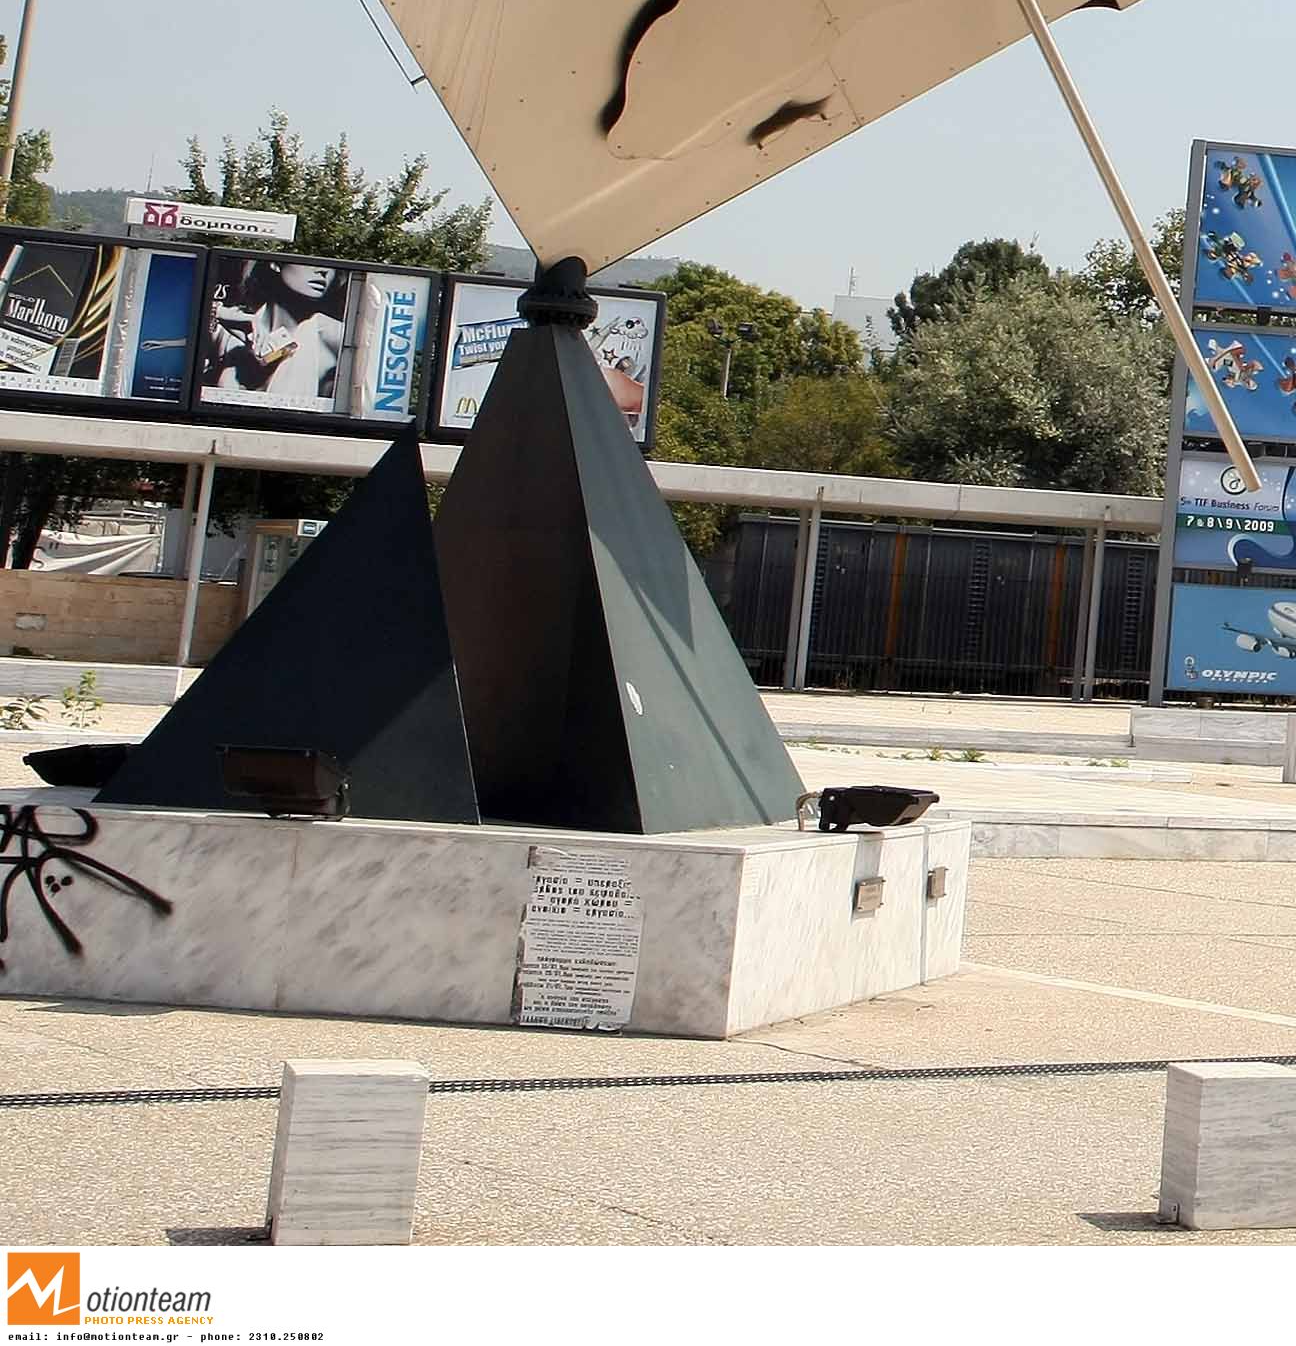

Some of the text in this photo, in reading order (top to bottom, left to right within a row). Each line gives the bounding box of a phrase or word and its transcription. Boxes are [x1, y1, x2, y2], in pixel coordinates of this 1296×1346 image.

[4, 297, 69, 333] Marlboro
[458, 343, 488, 356] Twist
[1211, 499, 1250, 510] Business
[1187, 515, 1195, 526] 7
[1244, 520, 1275, 532] 2009
[1202, 669, 1278, 681] OLYMPIC
